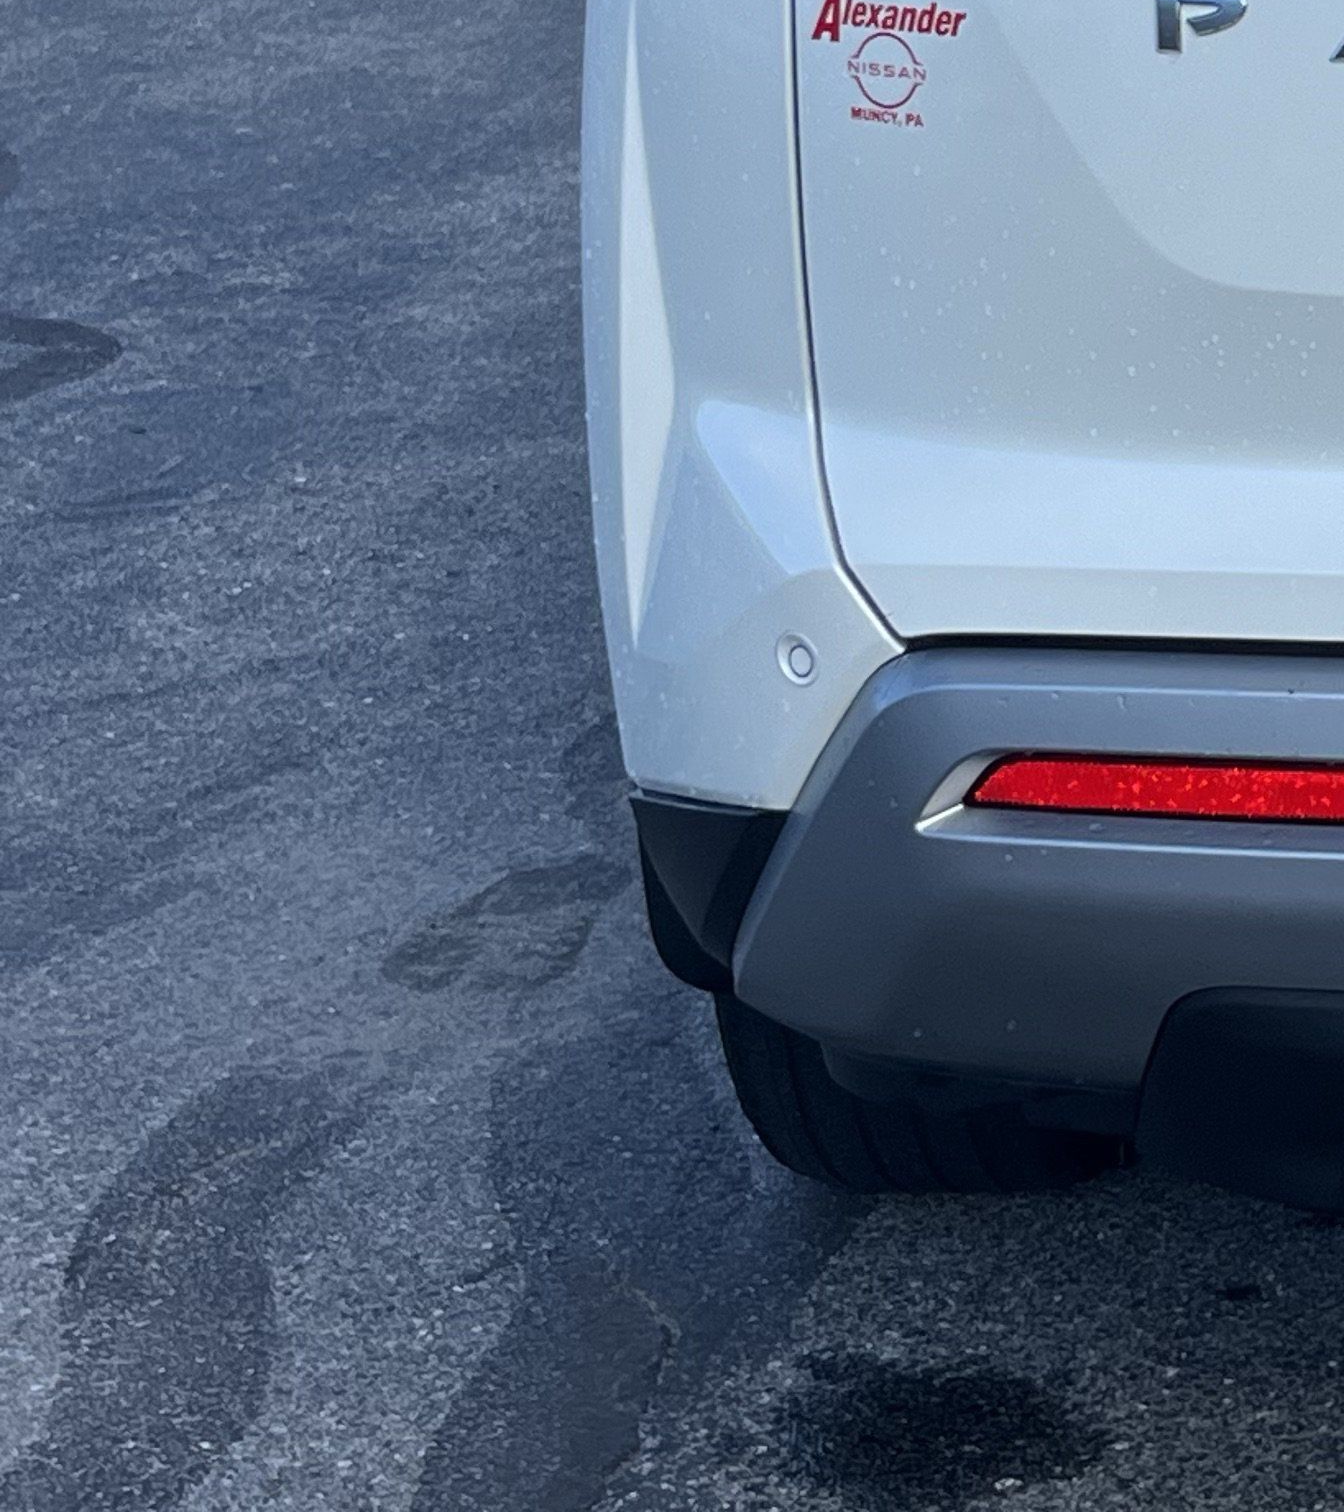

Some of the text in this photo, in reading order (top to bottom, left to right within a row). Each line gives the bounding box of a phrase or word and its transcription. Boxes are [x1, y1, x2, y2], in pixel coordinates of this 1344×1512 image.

[847, 60, 926, 81] NISSAN
[850, 107, 924, 127] MUNCY, PA
